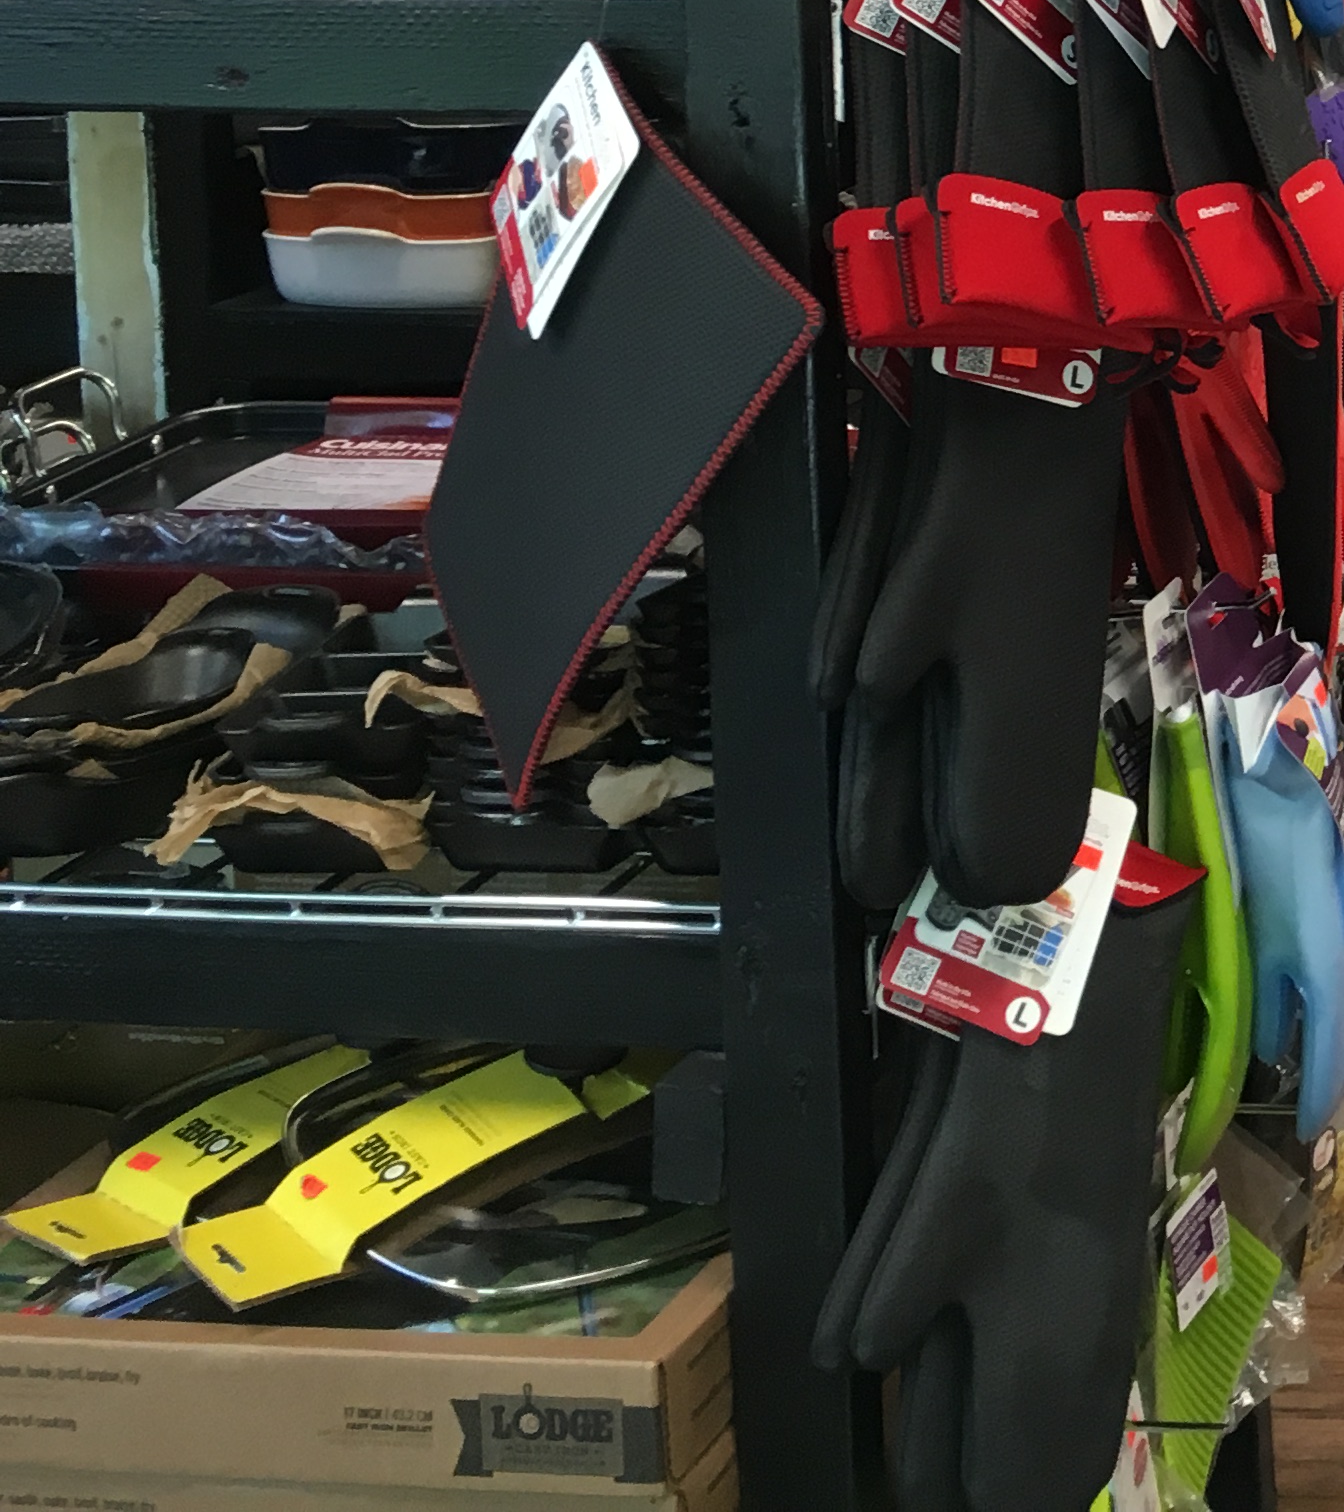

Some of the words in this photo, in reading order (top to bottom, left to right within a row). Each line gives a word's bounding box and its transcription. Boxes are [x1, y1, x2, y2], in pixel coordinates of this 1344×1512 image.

[580, 60, 602, 126] Kitchen
[970, 191, 1040, 220] KitchenGrips
[1068, 365, 1086, 389] L
[1012, 1002, 1028, 1029] L
[172, 1117, 250, 1164] LODGE
[350, 1132, 424, 1195] LODGE
[491, 1384, 614, 1443] LODGE
